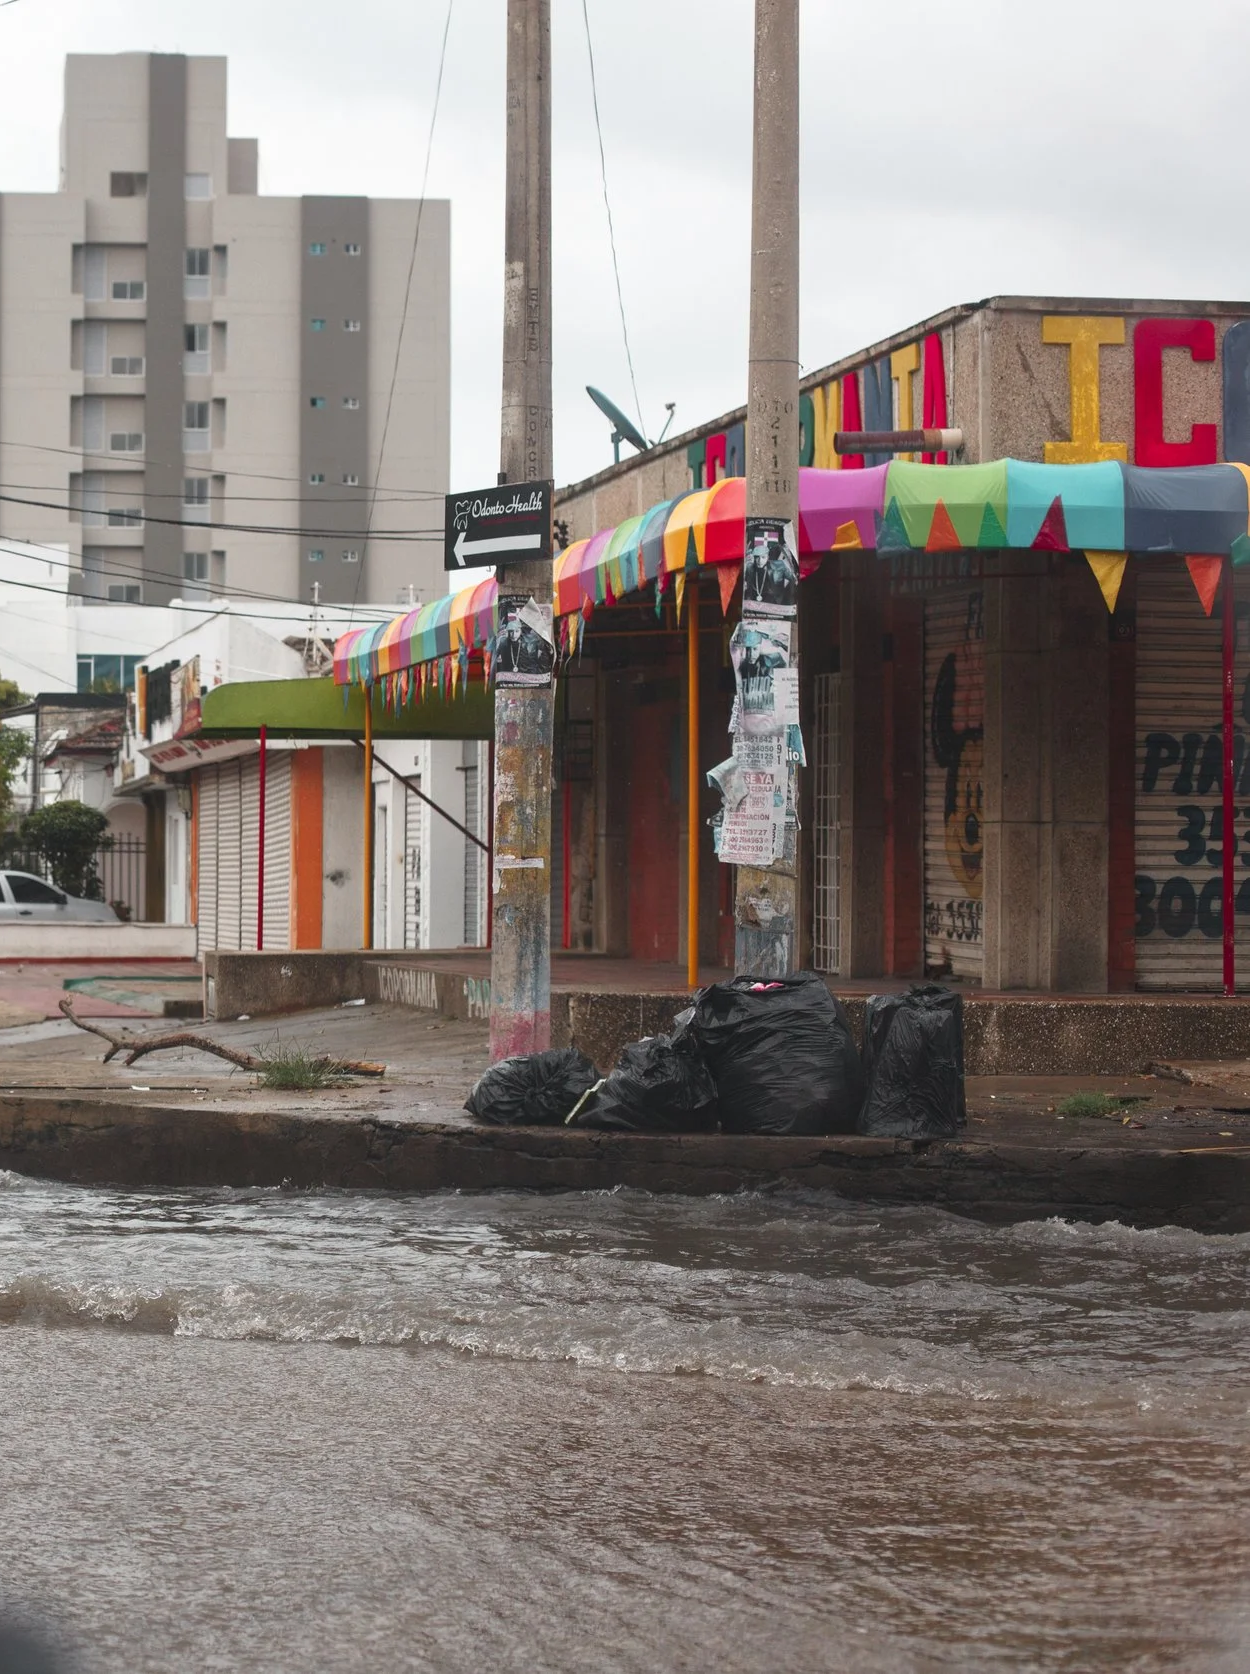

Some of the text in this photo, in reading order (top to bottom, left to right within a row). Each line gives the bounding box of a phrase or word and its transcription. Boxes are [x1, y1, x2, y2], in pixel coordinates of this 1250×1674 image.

[472, 491, 542, 519] Odonto Health
[1143, 723, 1250, 796] PIÑ
[759, 774, 773, 784] YA
[377, 966, 439, 1009] ICOPORMANIA
